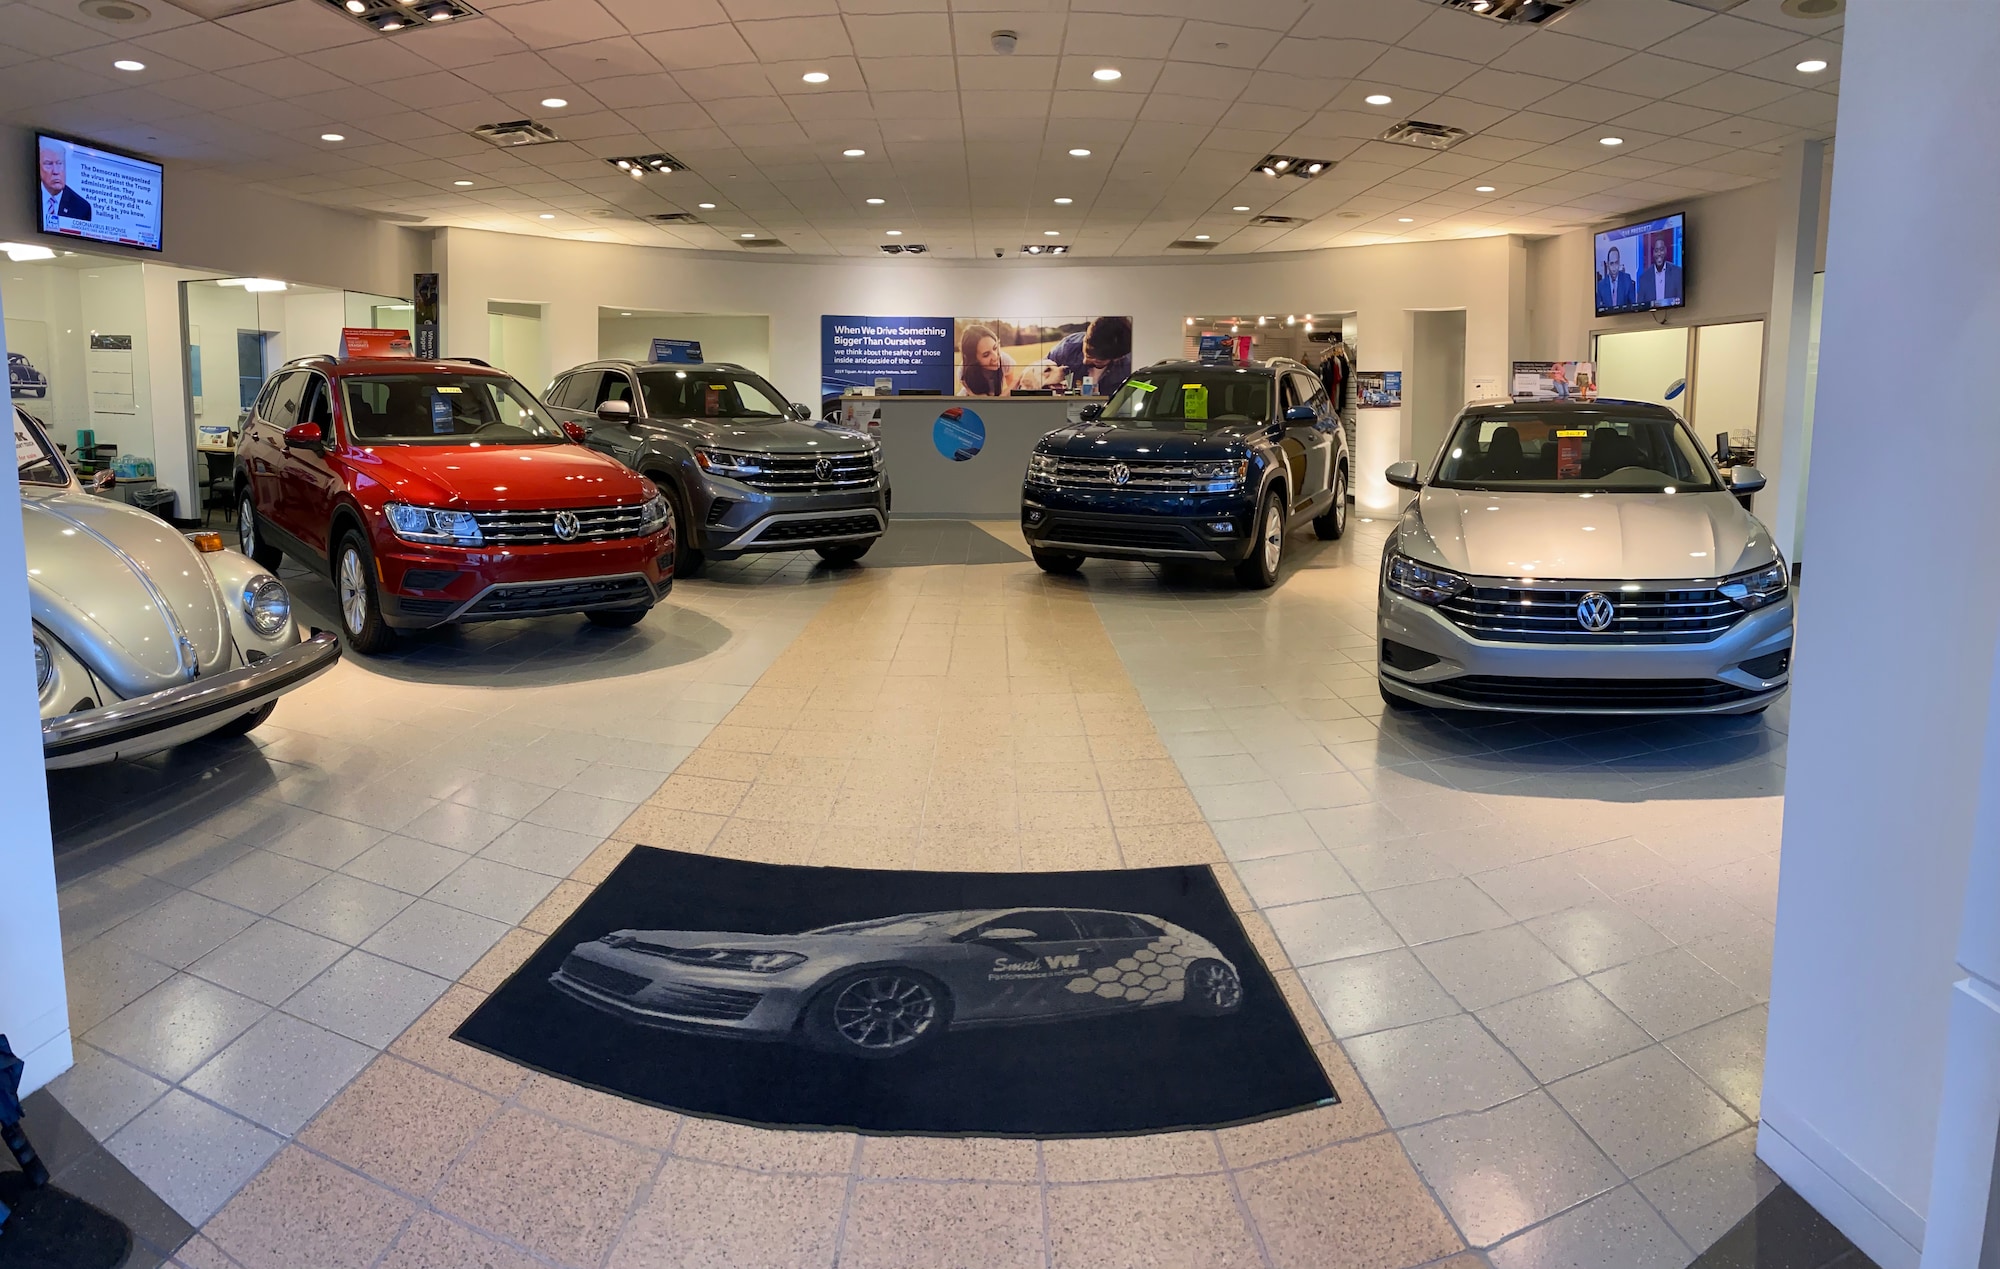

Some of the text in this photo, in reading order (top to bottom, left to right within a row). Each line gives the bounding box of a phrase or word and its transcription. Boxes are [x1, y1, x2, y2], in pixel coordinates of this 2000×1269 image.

[92, 166, 120, 178] Democrats
[121, 174, 151, 185] weaponized
[105, 178, 125, 186] against
[135, 183, 151, 193] Trump
[122, 187, 135, 197] They
[81, 187, 113, 198] weaponized
[114, 194, 136, 204] anything
[114, 200, 125, 208] they
[72, 219, 105, 231] CORONAVIRUS
[105, 225, 127, 234] RESPONSE
[834, 325, 947, 338] When We Drive Something
[834, 336, 927, 347] Bigger Than Ourselves
[863, 348, 881, 356] about
[892, 348, 913, 357] safety
[914, 348, 922, 356] of
[922, 348, 941, 356] those
[992, 954, 1080, 972] Smith VW
[988, 972, 1047, 981] Performance
